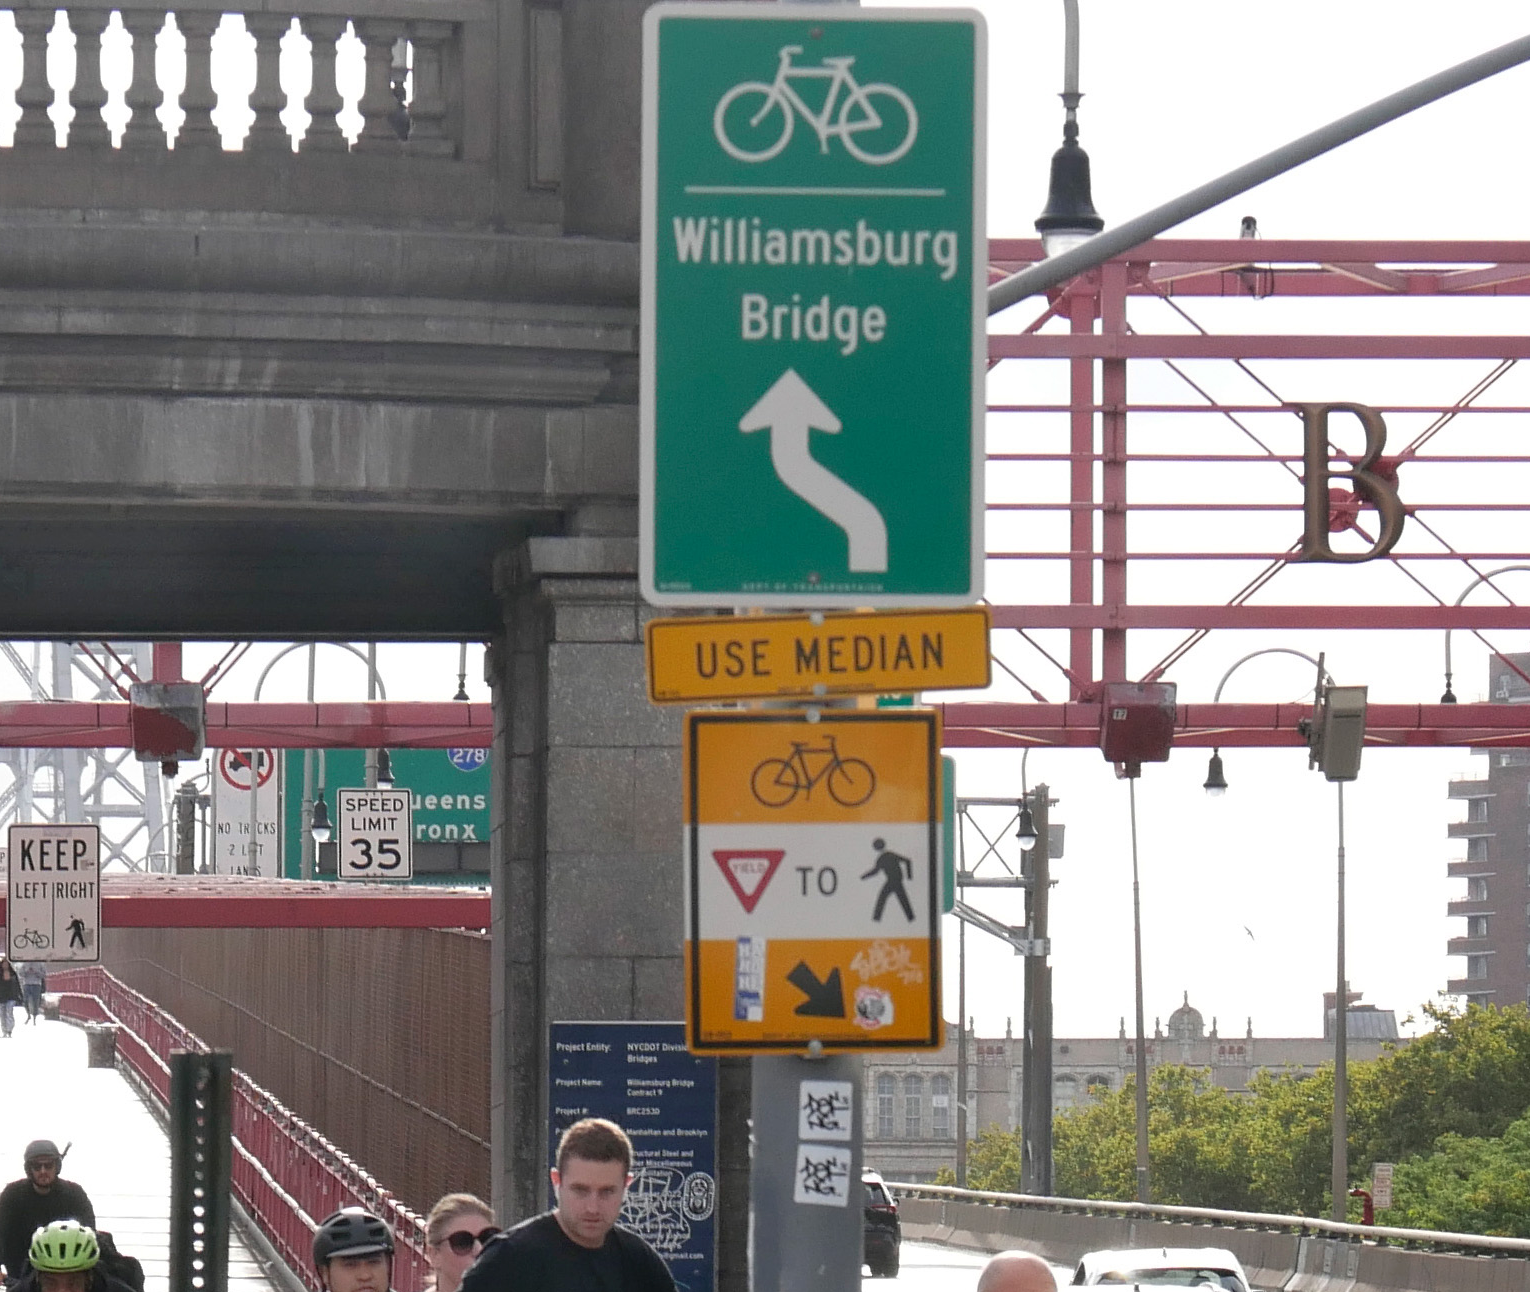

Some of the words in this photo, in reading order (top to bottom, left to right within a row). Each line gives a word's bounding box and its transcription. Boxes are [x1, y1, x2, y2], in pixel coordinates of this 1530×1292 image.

[672, 216, 959, 281] Williamsburg
[741, 293, 887, 356] Bridge
[695, 638, 771, 680] USE
[794, 631, 945, 675] MEDIAN
[453, 748, 485, 763] 278
[345, 798, 404, 812] SPEED
[411, 793, 486, 810] ueens
[218, 821, 231, 835] NO
[238, 821, 276, 835] TRCKS
[351, 817, 398, 831] LIMIT
[417, 822, 478, 839] ronx
[21, 839, 88, 871] KEEP
[349, 838, 401, 870] 35
[795, 865, 839, 896] TO
[15, 882, 48, 899] LEFT
[56, 882, 95, 899] RIGHT
[556, 1043, 584, 1053] Project
[586, 1042, 612, 1053] Entity:
[627, 1043, 659, 1051] NYCDOT
[627, 1054, 658, 1064] Bridges
[555, 1078, 580, 1088] Project
[627, 1078, 670, 1088] Williamsburg
[672, 1078, 695, 1088] Bridge
[627, 1088, 656, 1097] Contract
[555, 1107, 580, 1117] Project
[677, 1128, 708, 1138] Brooklyn
